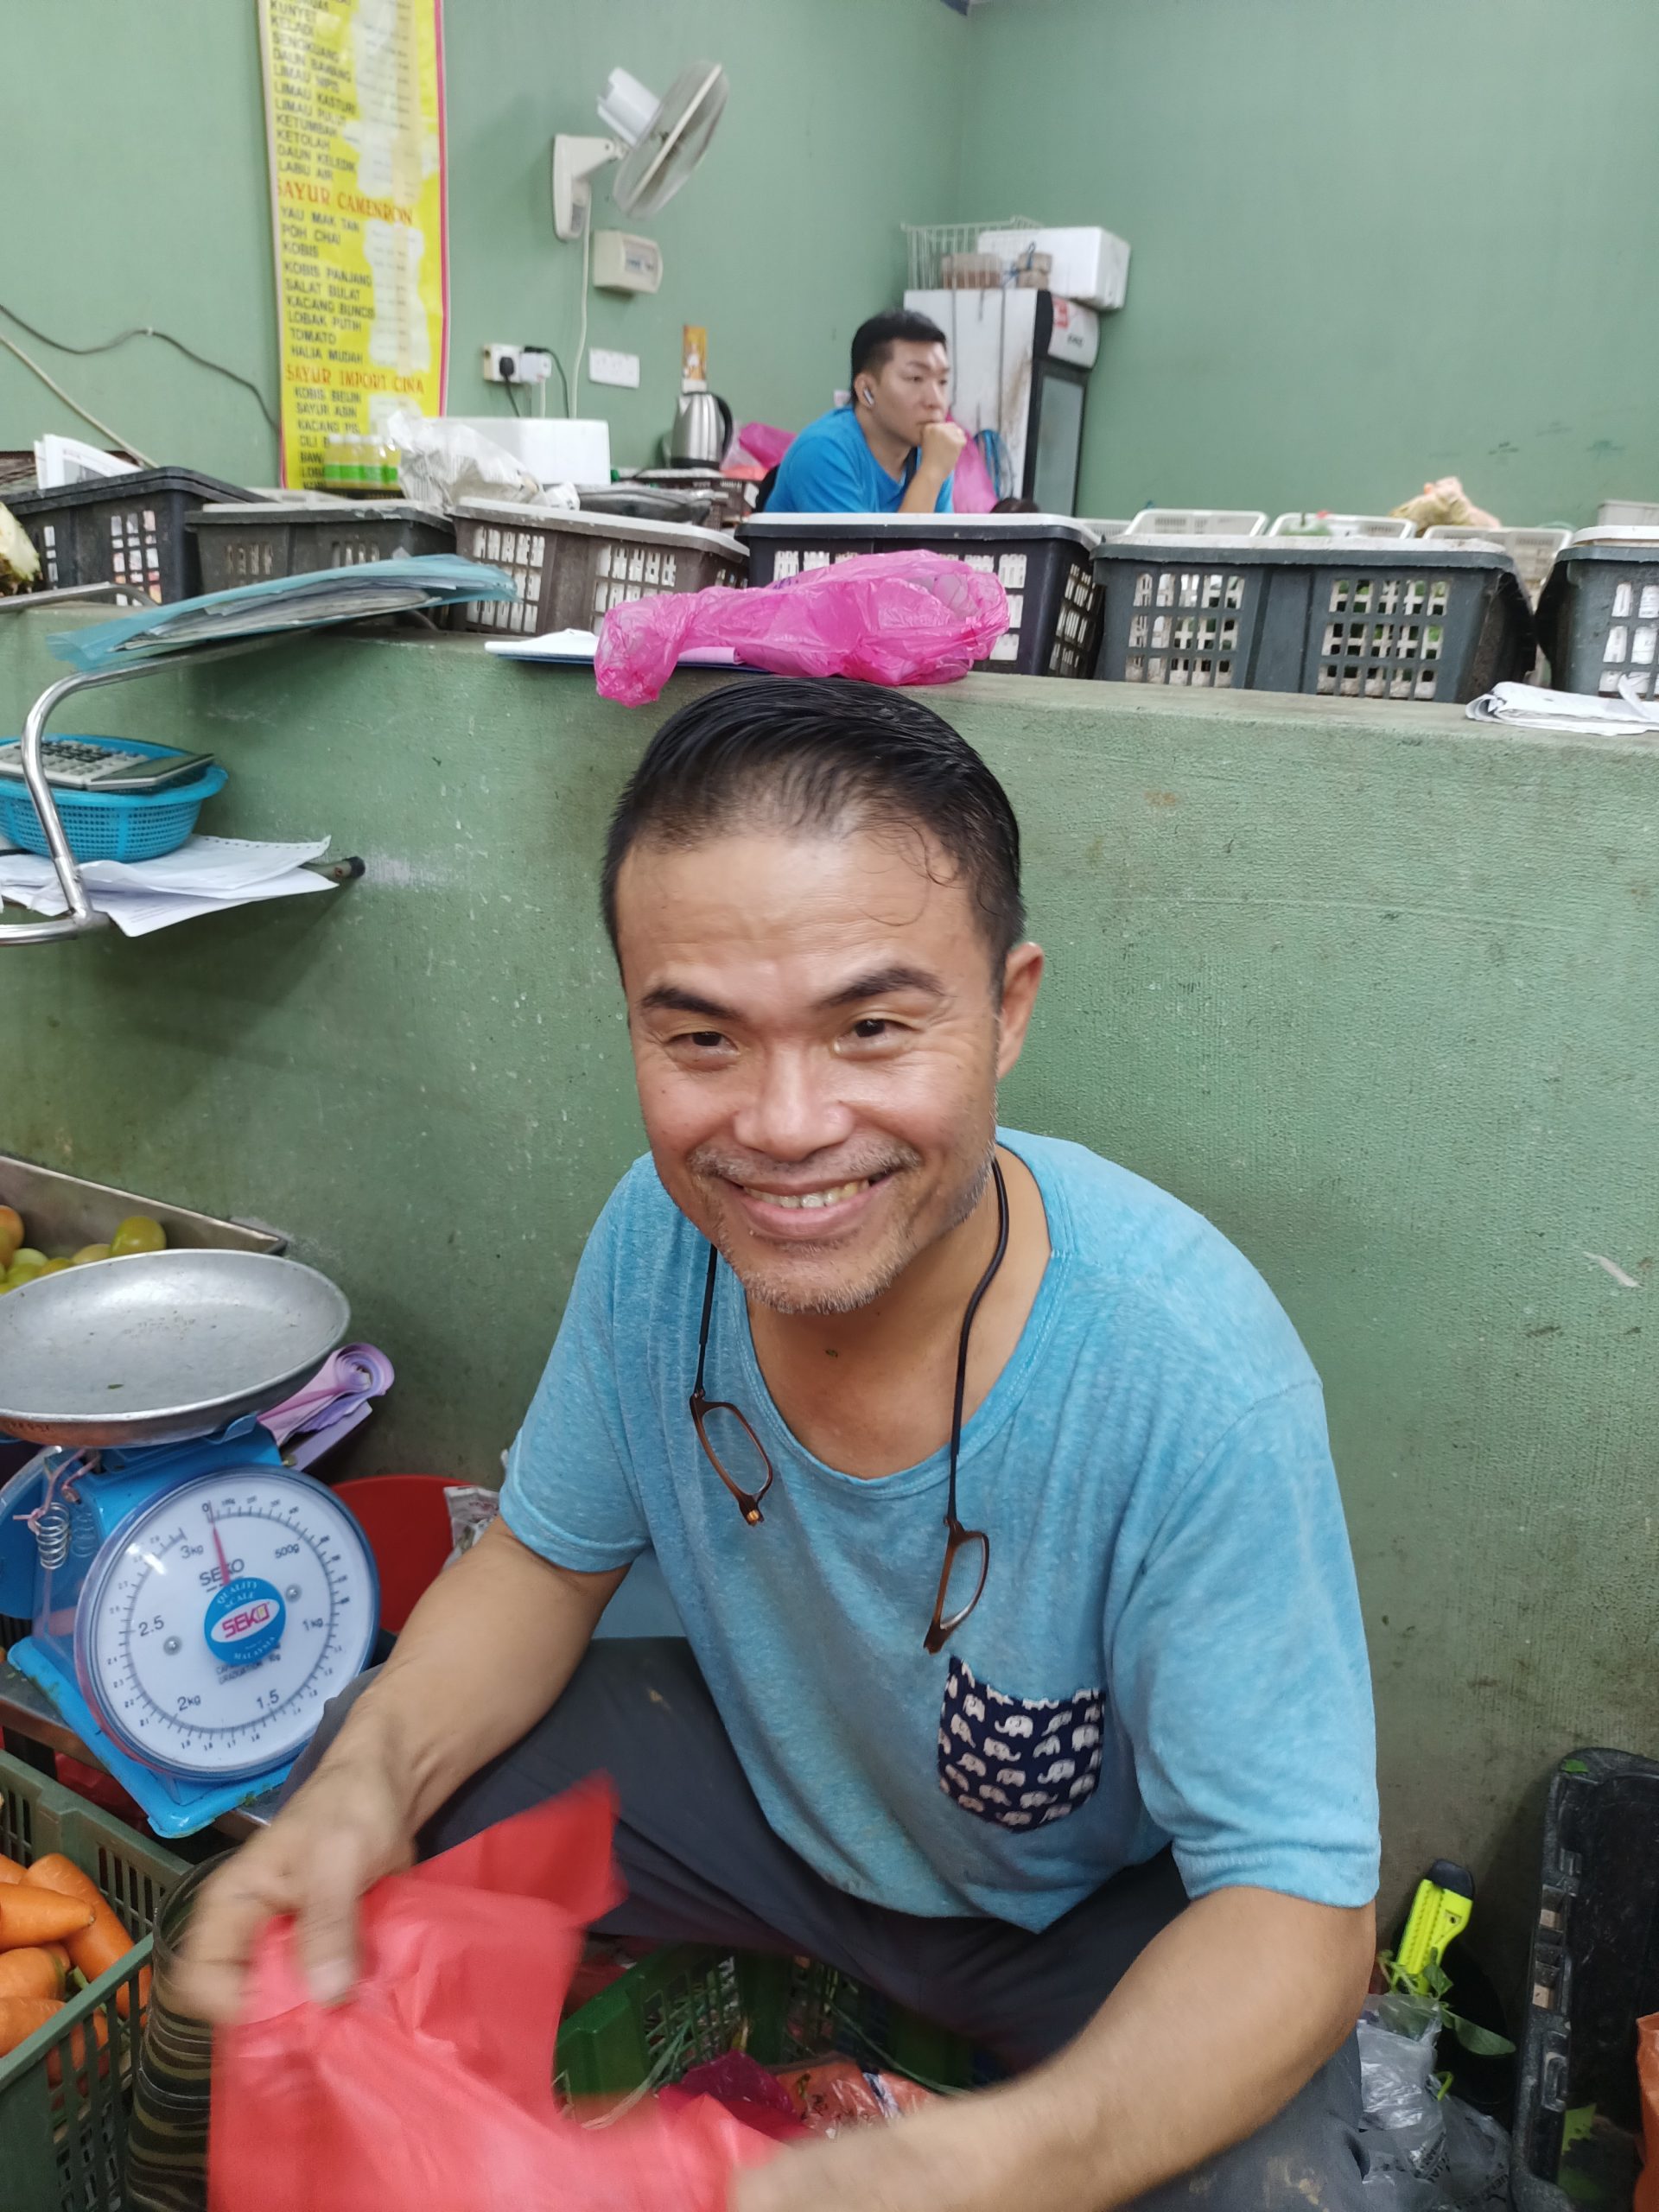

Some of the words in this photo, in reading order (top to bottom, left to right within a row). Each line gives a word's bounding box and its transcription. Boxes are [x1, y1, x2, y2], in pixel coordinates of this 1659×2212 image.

[275, 79, 311, 101] LIMAU
[276, 97, 312, 118] LIMAU
[276, 143, 311, 162] DAUN
[283, 242, 319, 257] KOBIS
[284, 261, 321, 278] KOBIS
[285, 277, 321, 296] SALAT
[286, 295, 335, 314] KACANG
[289, 310, 327, 327] LOBAK
[289, 327, 337, 346] TOMATO
[286, 364, 332, 385] SAYUR
[340, 370, 388, 391] IMPORT
[393, 376, 426, 395] CINA
[180, 1544, 204, 1559] 3kg
[274, 1543, 300, 1559] 500g
[217, 1580, 257, 1605] QUALITY
[225, 1591, 255, 1608] SCALE
[138, 1614, 165, 1637] 2.5
[222, 1602, 270, 1638] SEKO
[302, 1618, 324, 1631] 1kg
[234, 1636, 276, 1660] MALAYSIA
[177, 1694, 201, 1712] 2kg
[257, 1688, 280, 1710] 1.5
